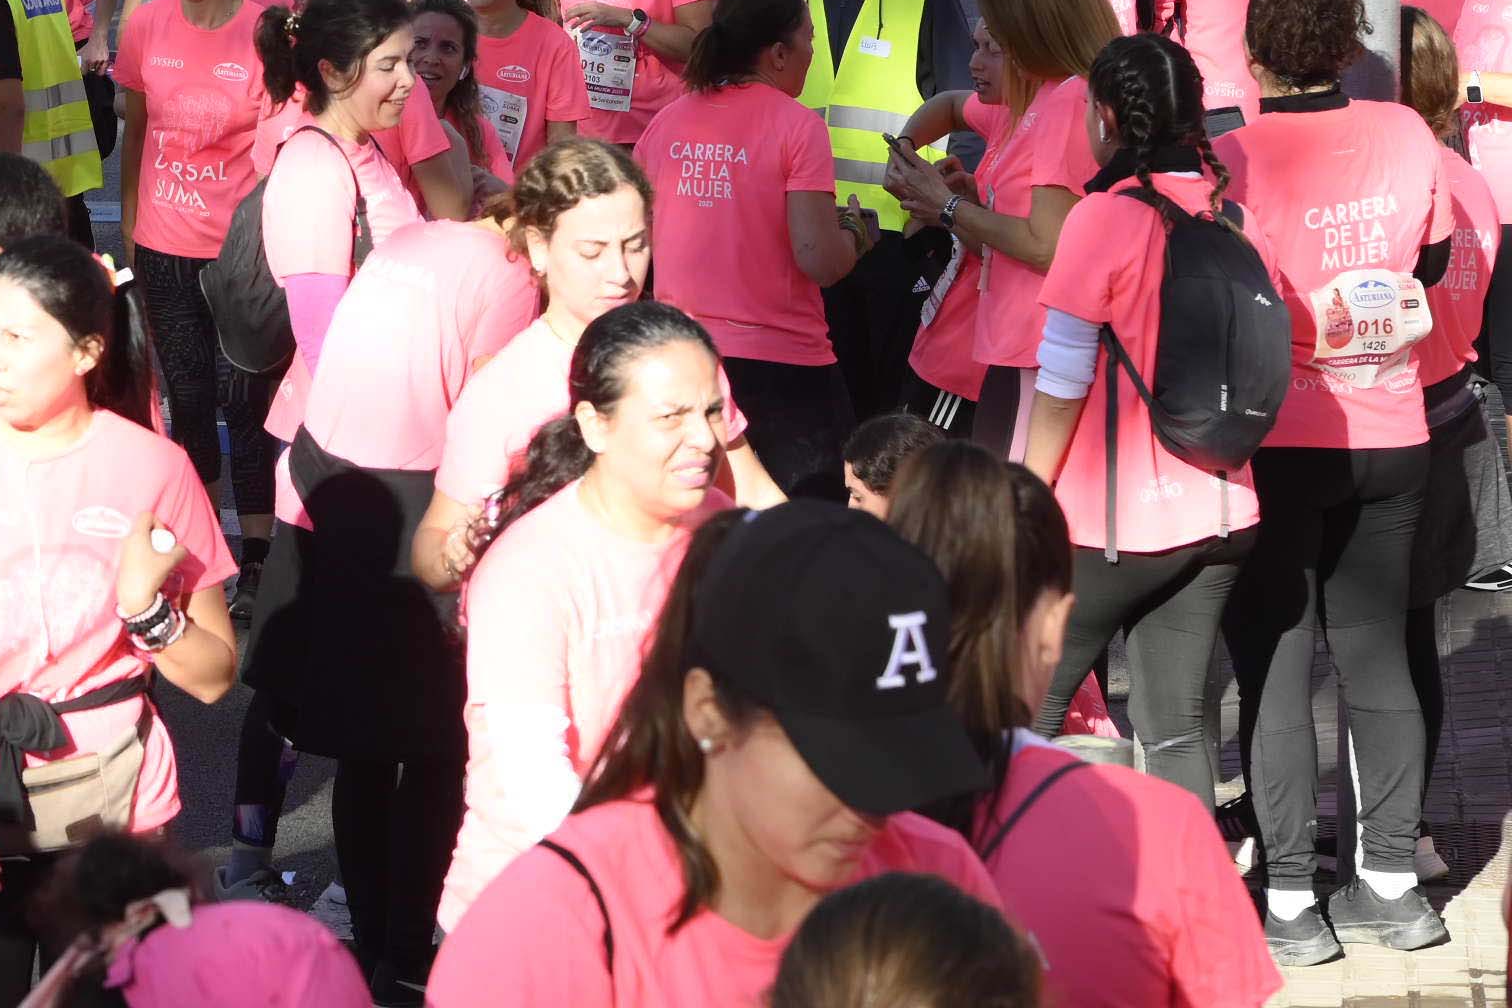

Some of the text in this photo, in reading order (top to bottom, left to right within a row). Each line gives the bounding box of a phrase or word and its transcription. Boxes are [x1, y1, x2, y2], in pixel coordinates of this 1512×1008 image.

[670, 141, 748, 164] CARRERA
[681, 161, 730, 180] DE LA
[155, 178, 207, 210] SUMA
[676, 181, 733, 200] MUJER
[698, 199, 714, 208] 2023
[1304, 194, 1399, 230] CARRERA
[1324, 220, 1386, 249] DE LA
[1454, 228, 1494, 250] RRERA
[1321, 241, 1389, 272] MUJER
[1357, 317, 1393, 335] 016
[1362, 340, 1386, 351] 1426
[877, 611, 936, 689] A
